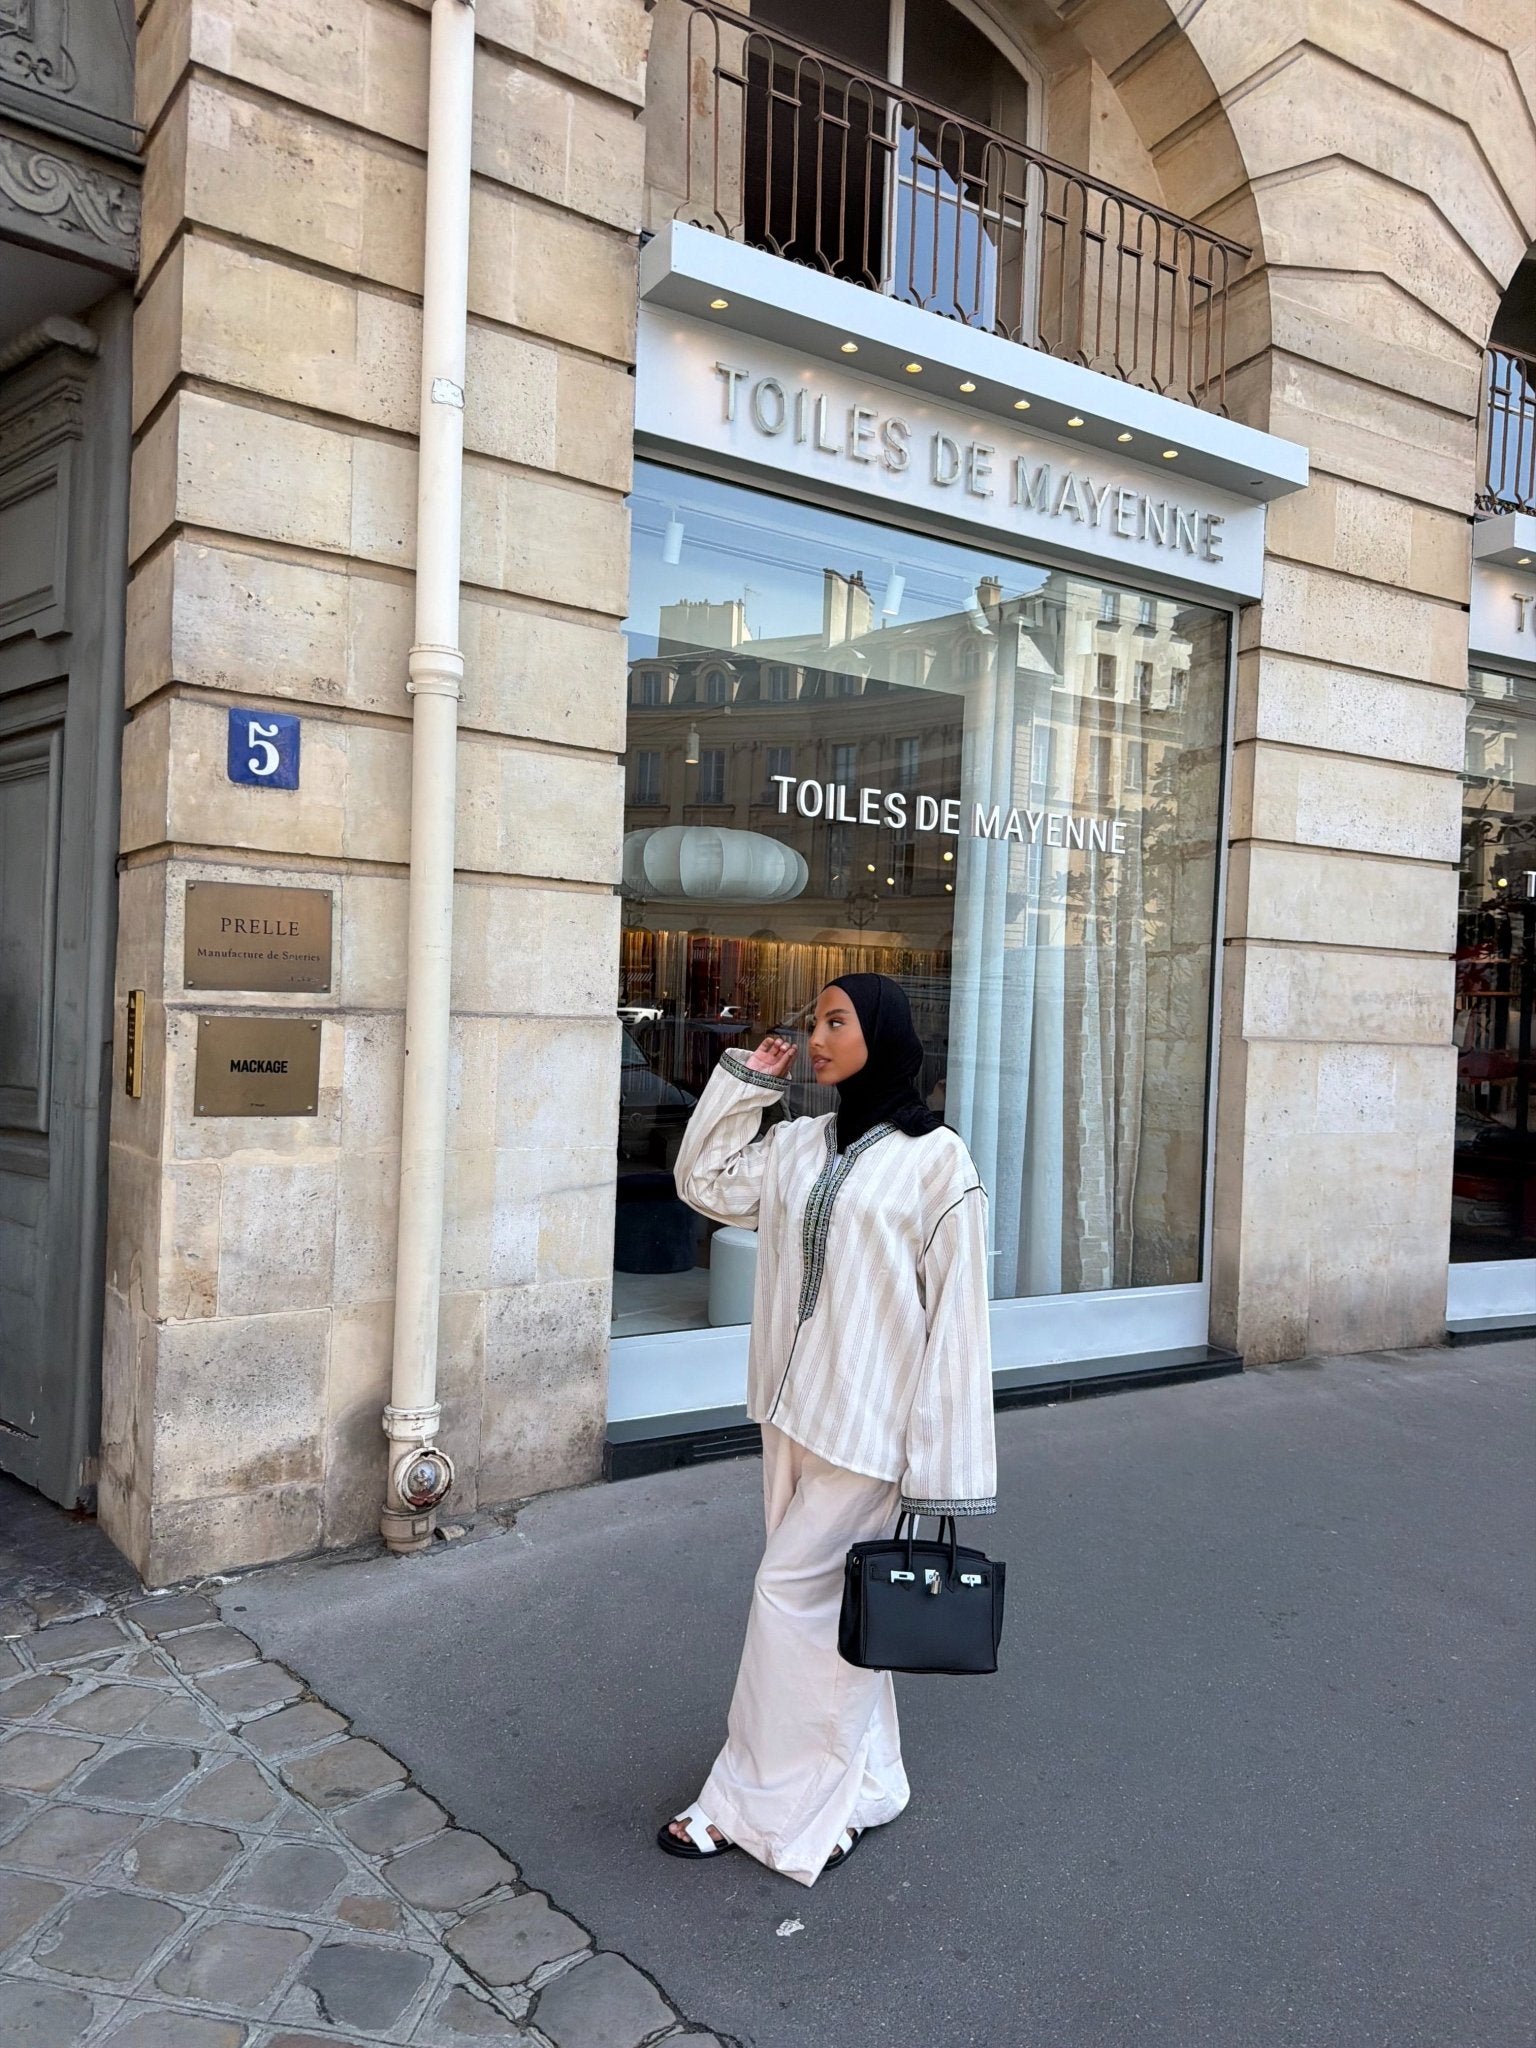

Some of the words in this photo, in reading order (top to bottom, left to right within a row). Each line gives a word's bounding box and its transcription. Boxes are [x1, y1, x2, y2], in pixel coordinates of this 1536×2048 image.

[715, 361, 911, 472] TOILES
[933, 430, 996, 497] DE
[1015, 455, 1225, 563] MAYENNE
[247, 721, 280, 776] 5
[770, 774, 908, 830] TOILES
[915, 795, 961, 835] DE
[971, 802, 1127, 855] MAYENNE
[220, 917, 300, 937] PRELLE
[196, 947, 264, 960] Manufacture
[267, 950, 279, 960] de
[229, 1058, 289, 1074] MACKAGE
